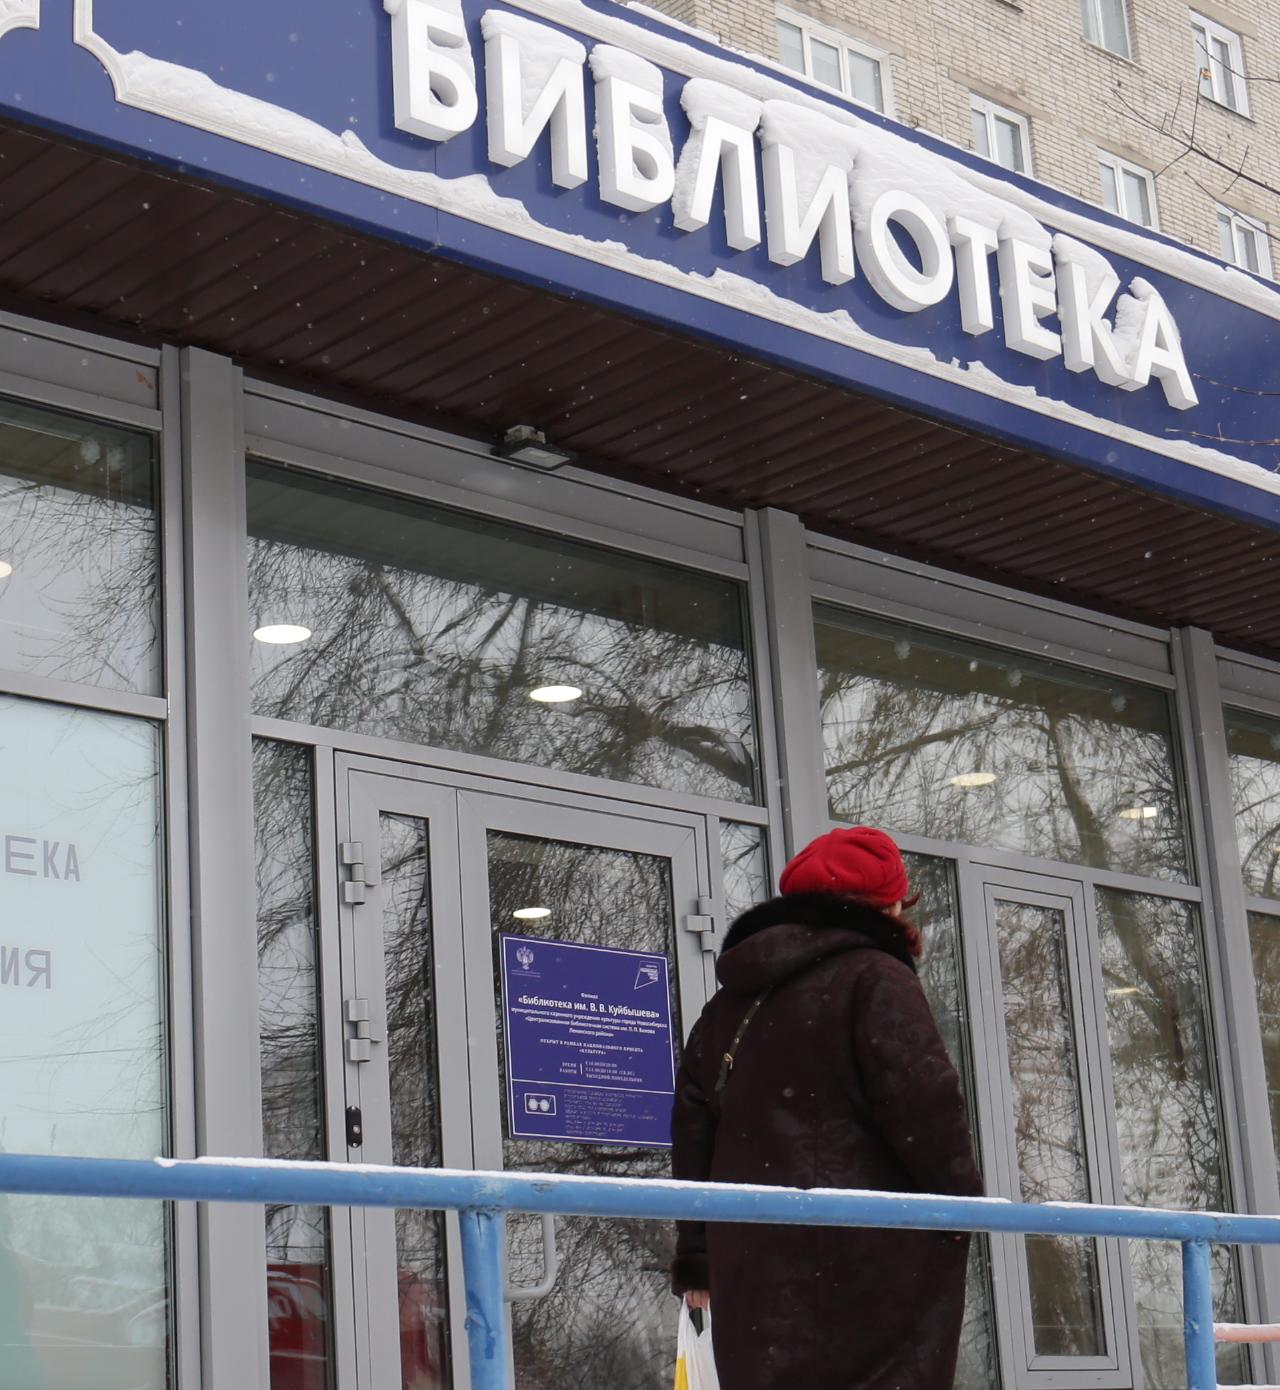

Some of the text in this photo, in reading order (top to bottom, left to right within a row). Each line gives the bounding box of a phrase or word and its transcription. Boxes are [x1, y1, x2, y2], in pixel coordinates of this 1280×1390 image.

[385, 0, 1199, 411] БИБЛИОТЕКА
[518, 994, 660, 1018] «Библиотека им. В. В. Куйбышева»
